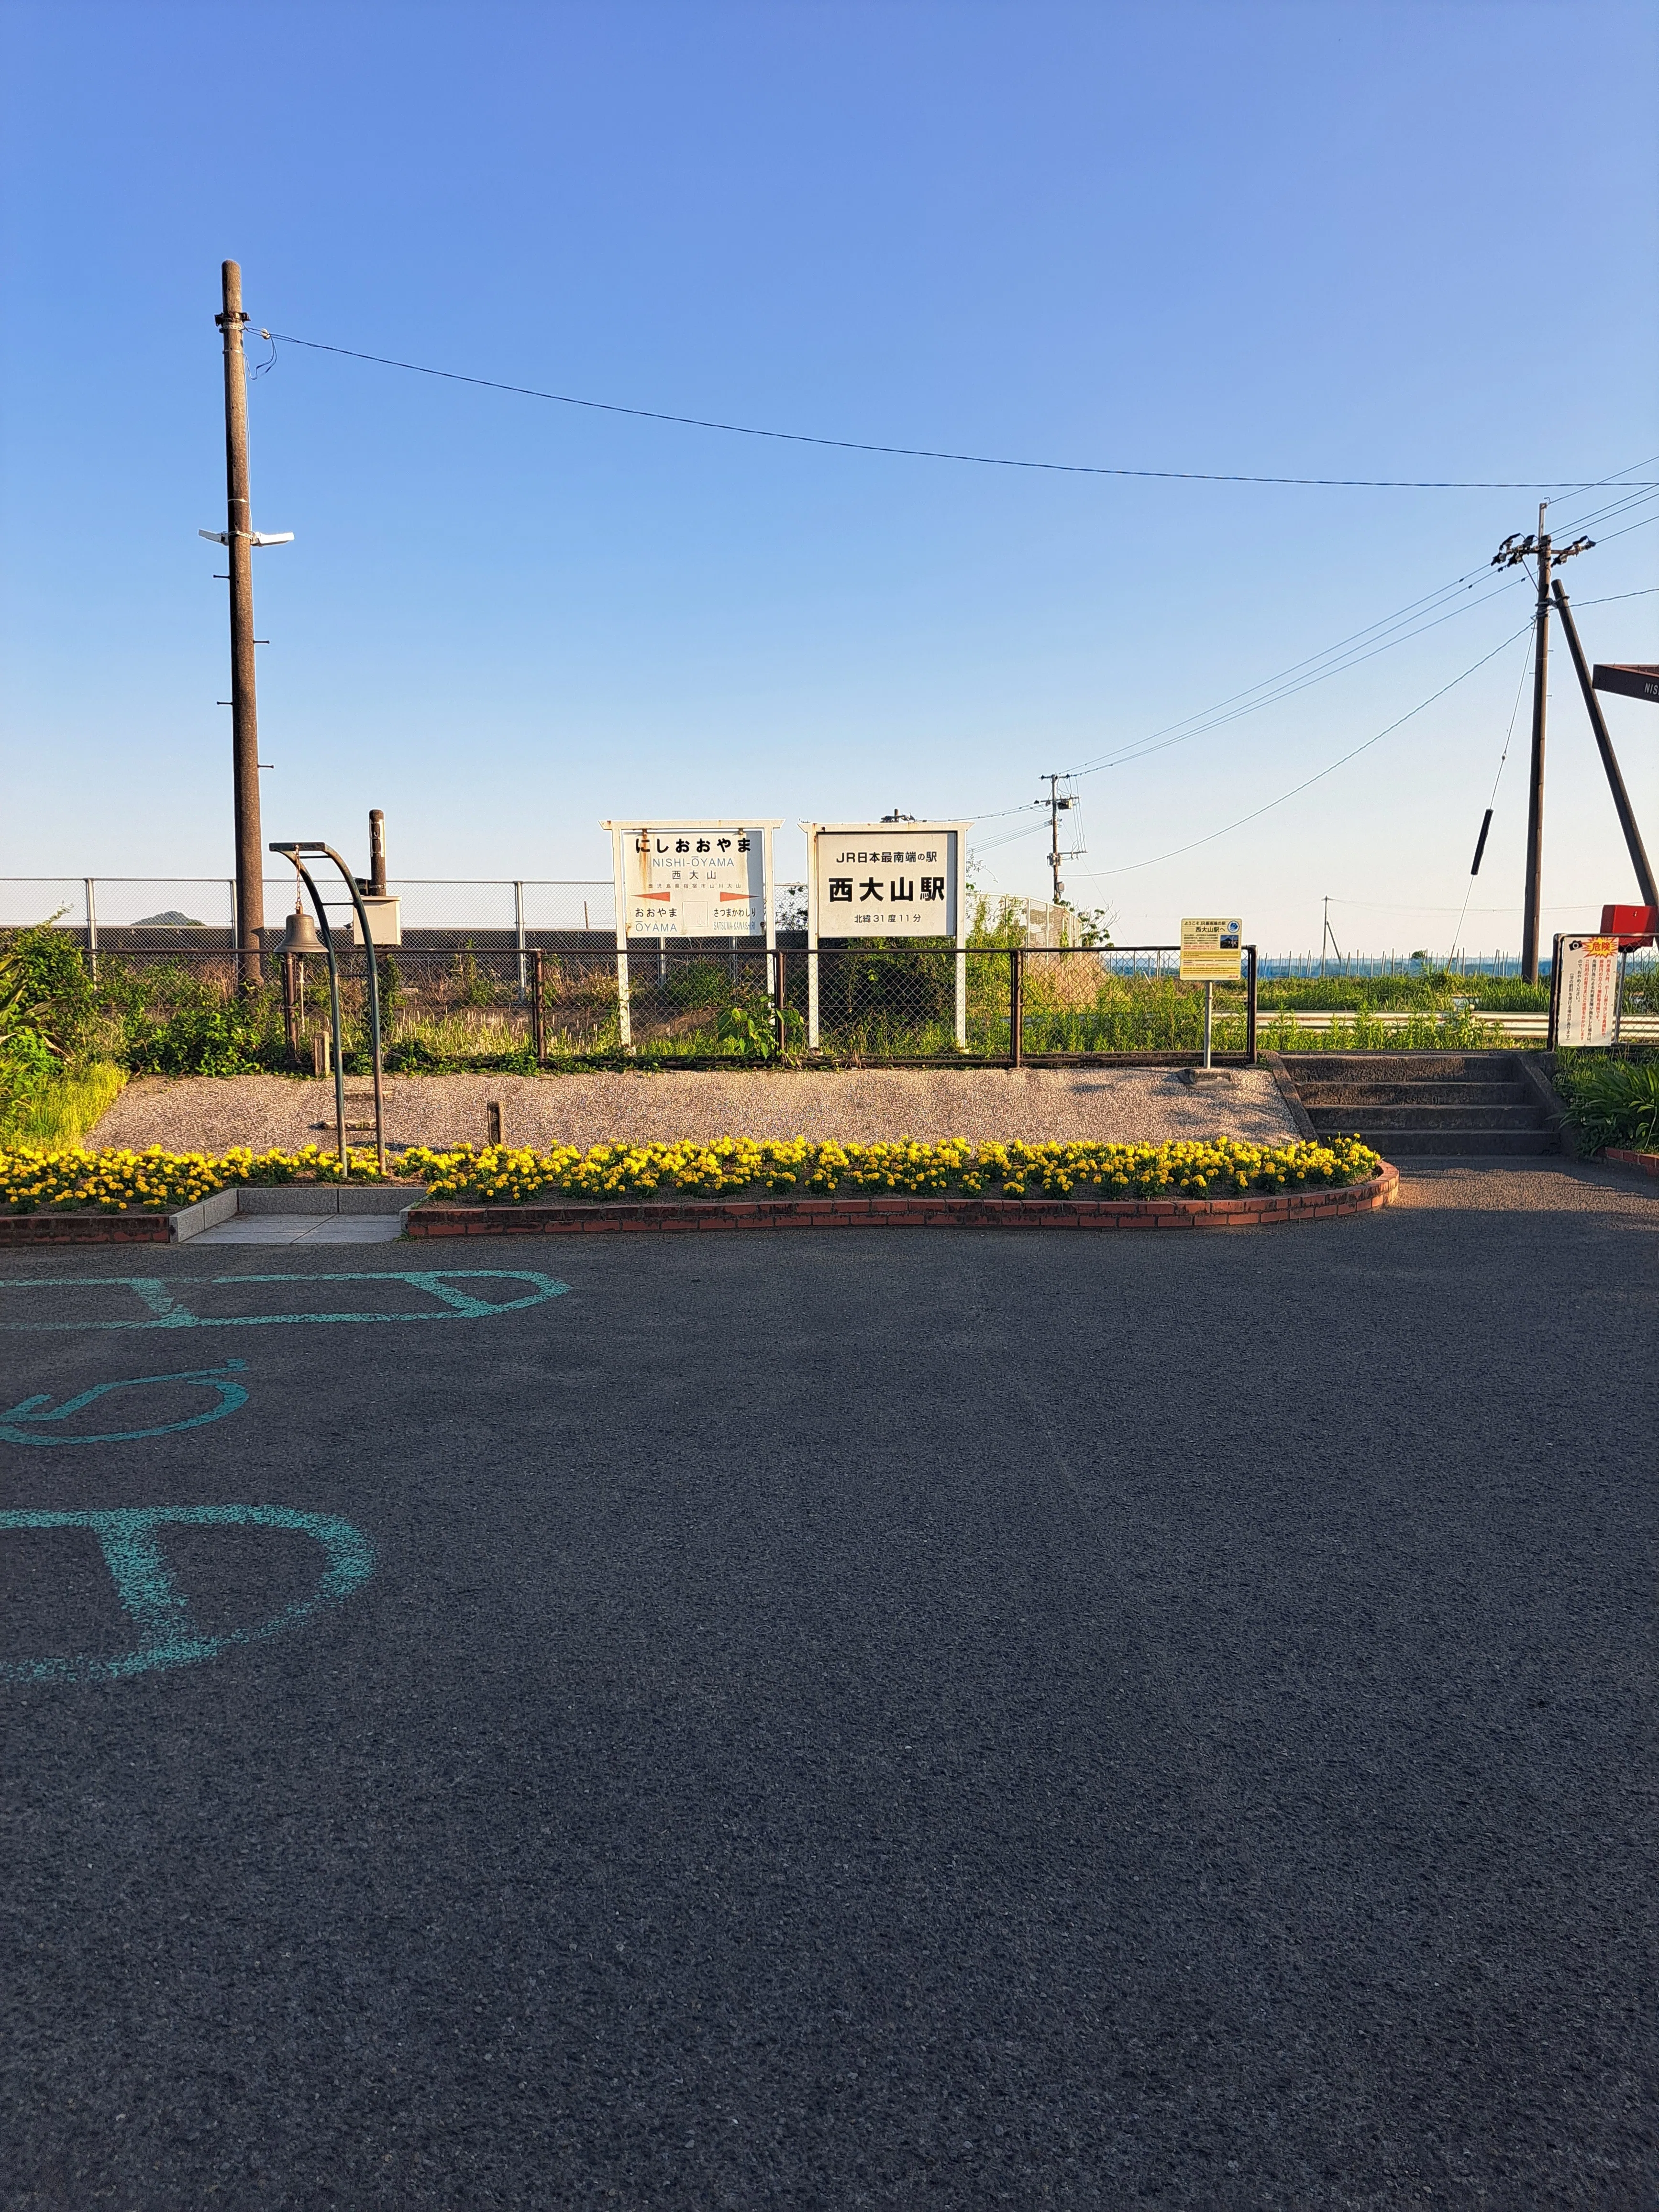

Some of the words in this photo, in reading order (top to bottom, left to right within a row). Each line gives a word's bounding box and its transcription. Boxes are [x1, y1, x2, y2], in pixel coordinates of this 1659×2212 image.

[1644, 683, 1659, 696] NIS
[635, 838, 751, 853] にしおおやま
[836, 851, 937, 863] JR日本最南端の駅
[672, 870, 716, 880] 西大山
[829, 876, 945, 903] 西大山駅
[635, 907, 677, 918] おおやま
[713, 907, 756, 918] さつまかわしり
[713, 921, 756, 931] SATSUMA-KAWASHIRI
[1593, 941, 1610, 951] 危険
